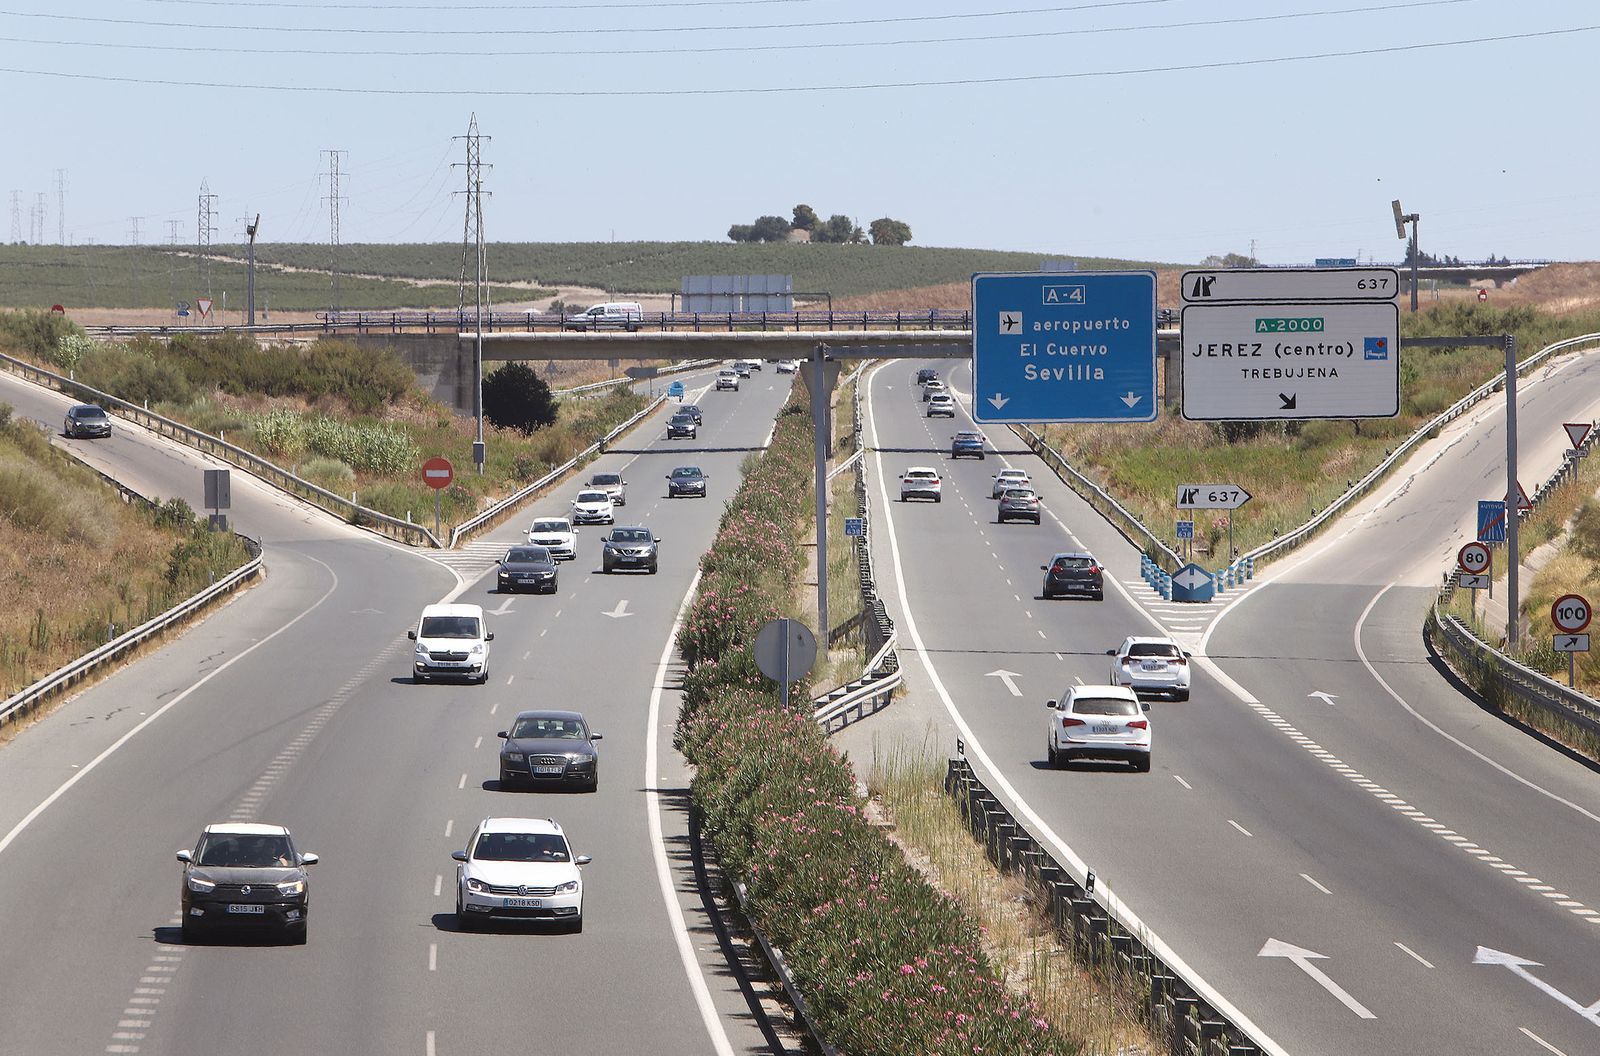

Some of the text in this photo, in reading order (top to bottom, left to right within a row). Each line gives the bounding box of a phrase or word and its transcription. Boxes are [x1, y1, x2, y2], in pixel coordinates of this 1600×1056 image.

[1357, 279, 1389, 291] 637
[1046, 288, 1082, 302] A-4
[1033, 317, 1130, 334] aeropuerto
[1258, 319, 1322, 331] A-2000
[1020, 343, 1107, 356] El Cuervo
[1191, 342, 1263, 358] JEREZ
[1275, 341, 1354, 360] (centro)
[1024, 365, 1104, 381] Sevilla
[1241, 367, 1339, 379] TREBUJENA
[1208, 491, 1239, 502] 637
[1465, 553, 1485, 564] 80
[1558, 607, 1586, 621] 100
